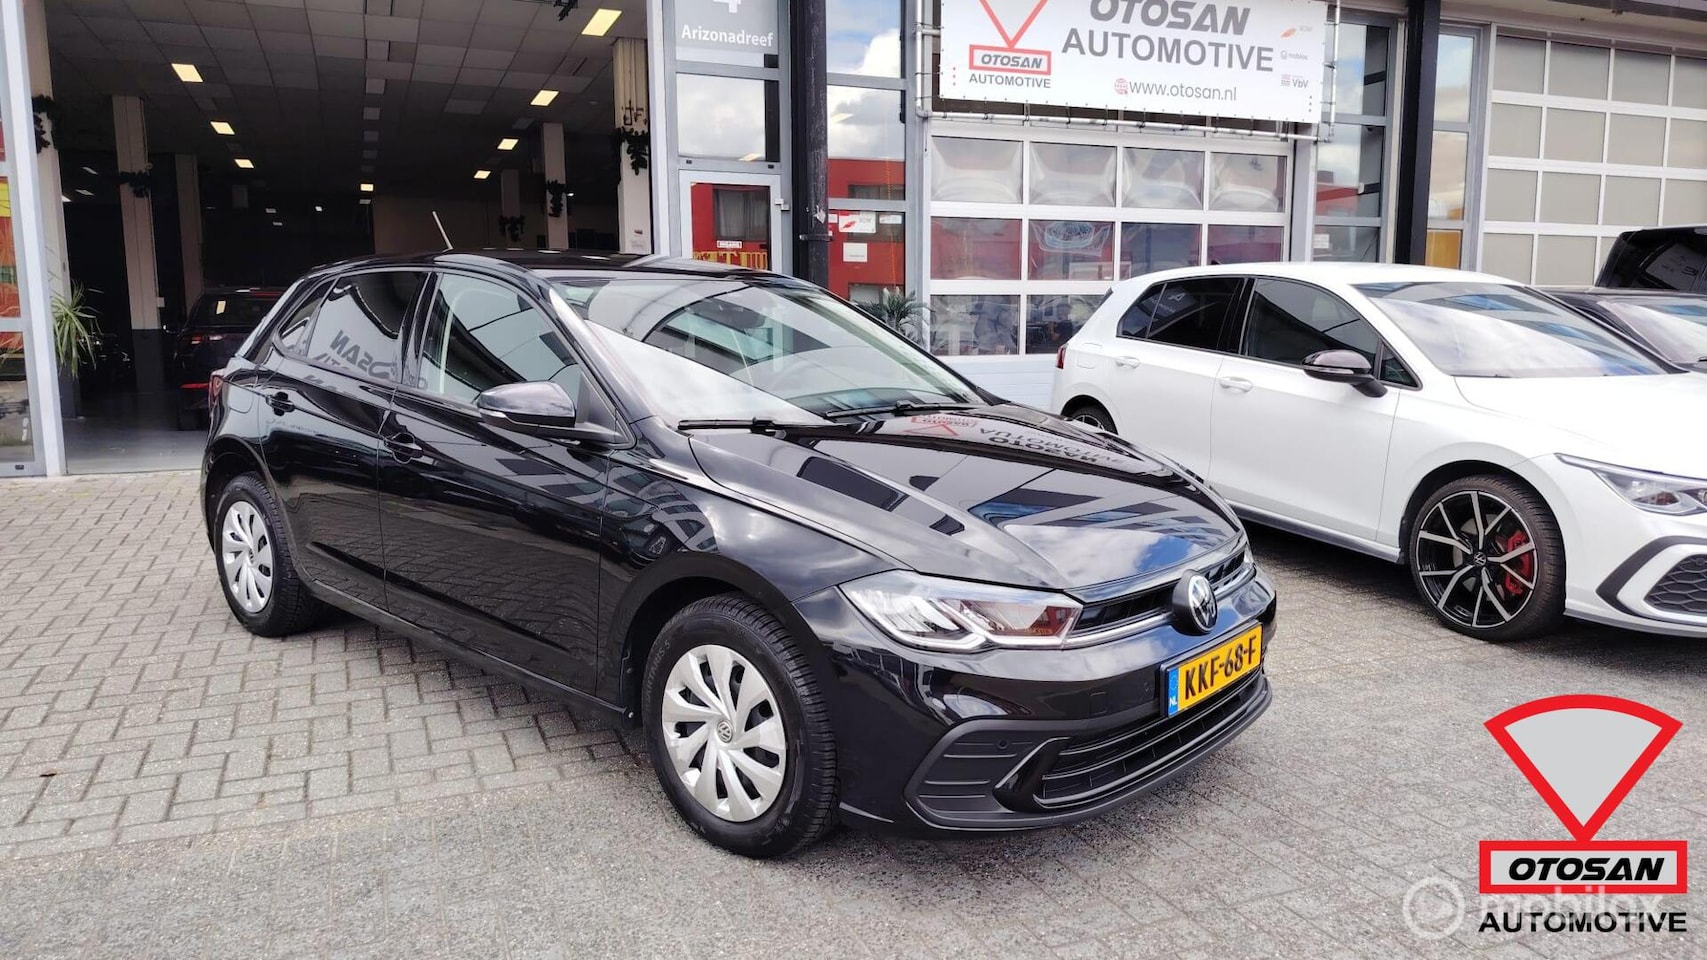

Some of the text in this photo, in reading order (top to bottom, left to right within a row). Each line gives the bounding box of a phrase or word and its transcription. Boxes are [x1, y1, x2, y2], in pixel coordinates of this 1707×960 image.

[1090, 0, 1250, 36] OTOSAN
[681, 24, 774, 47] Arizonadreef
[1061, 27, 1274, 72] AUTOMOTIVE
[981, 53, 1043, 69] OTOSAN
[969, 73, 1051, 89] AUTOMOTIVE
[1129, 81, 1237, 101] www.otosan.nl
[1185, 634, 1257, 700] KKF-68-F
[1169, 697, 1178, 707] NL
